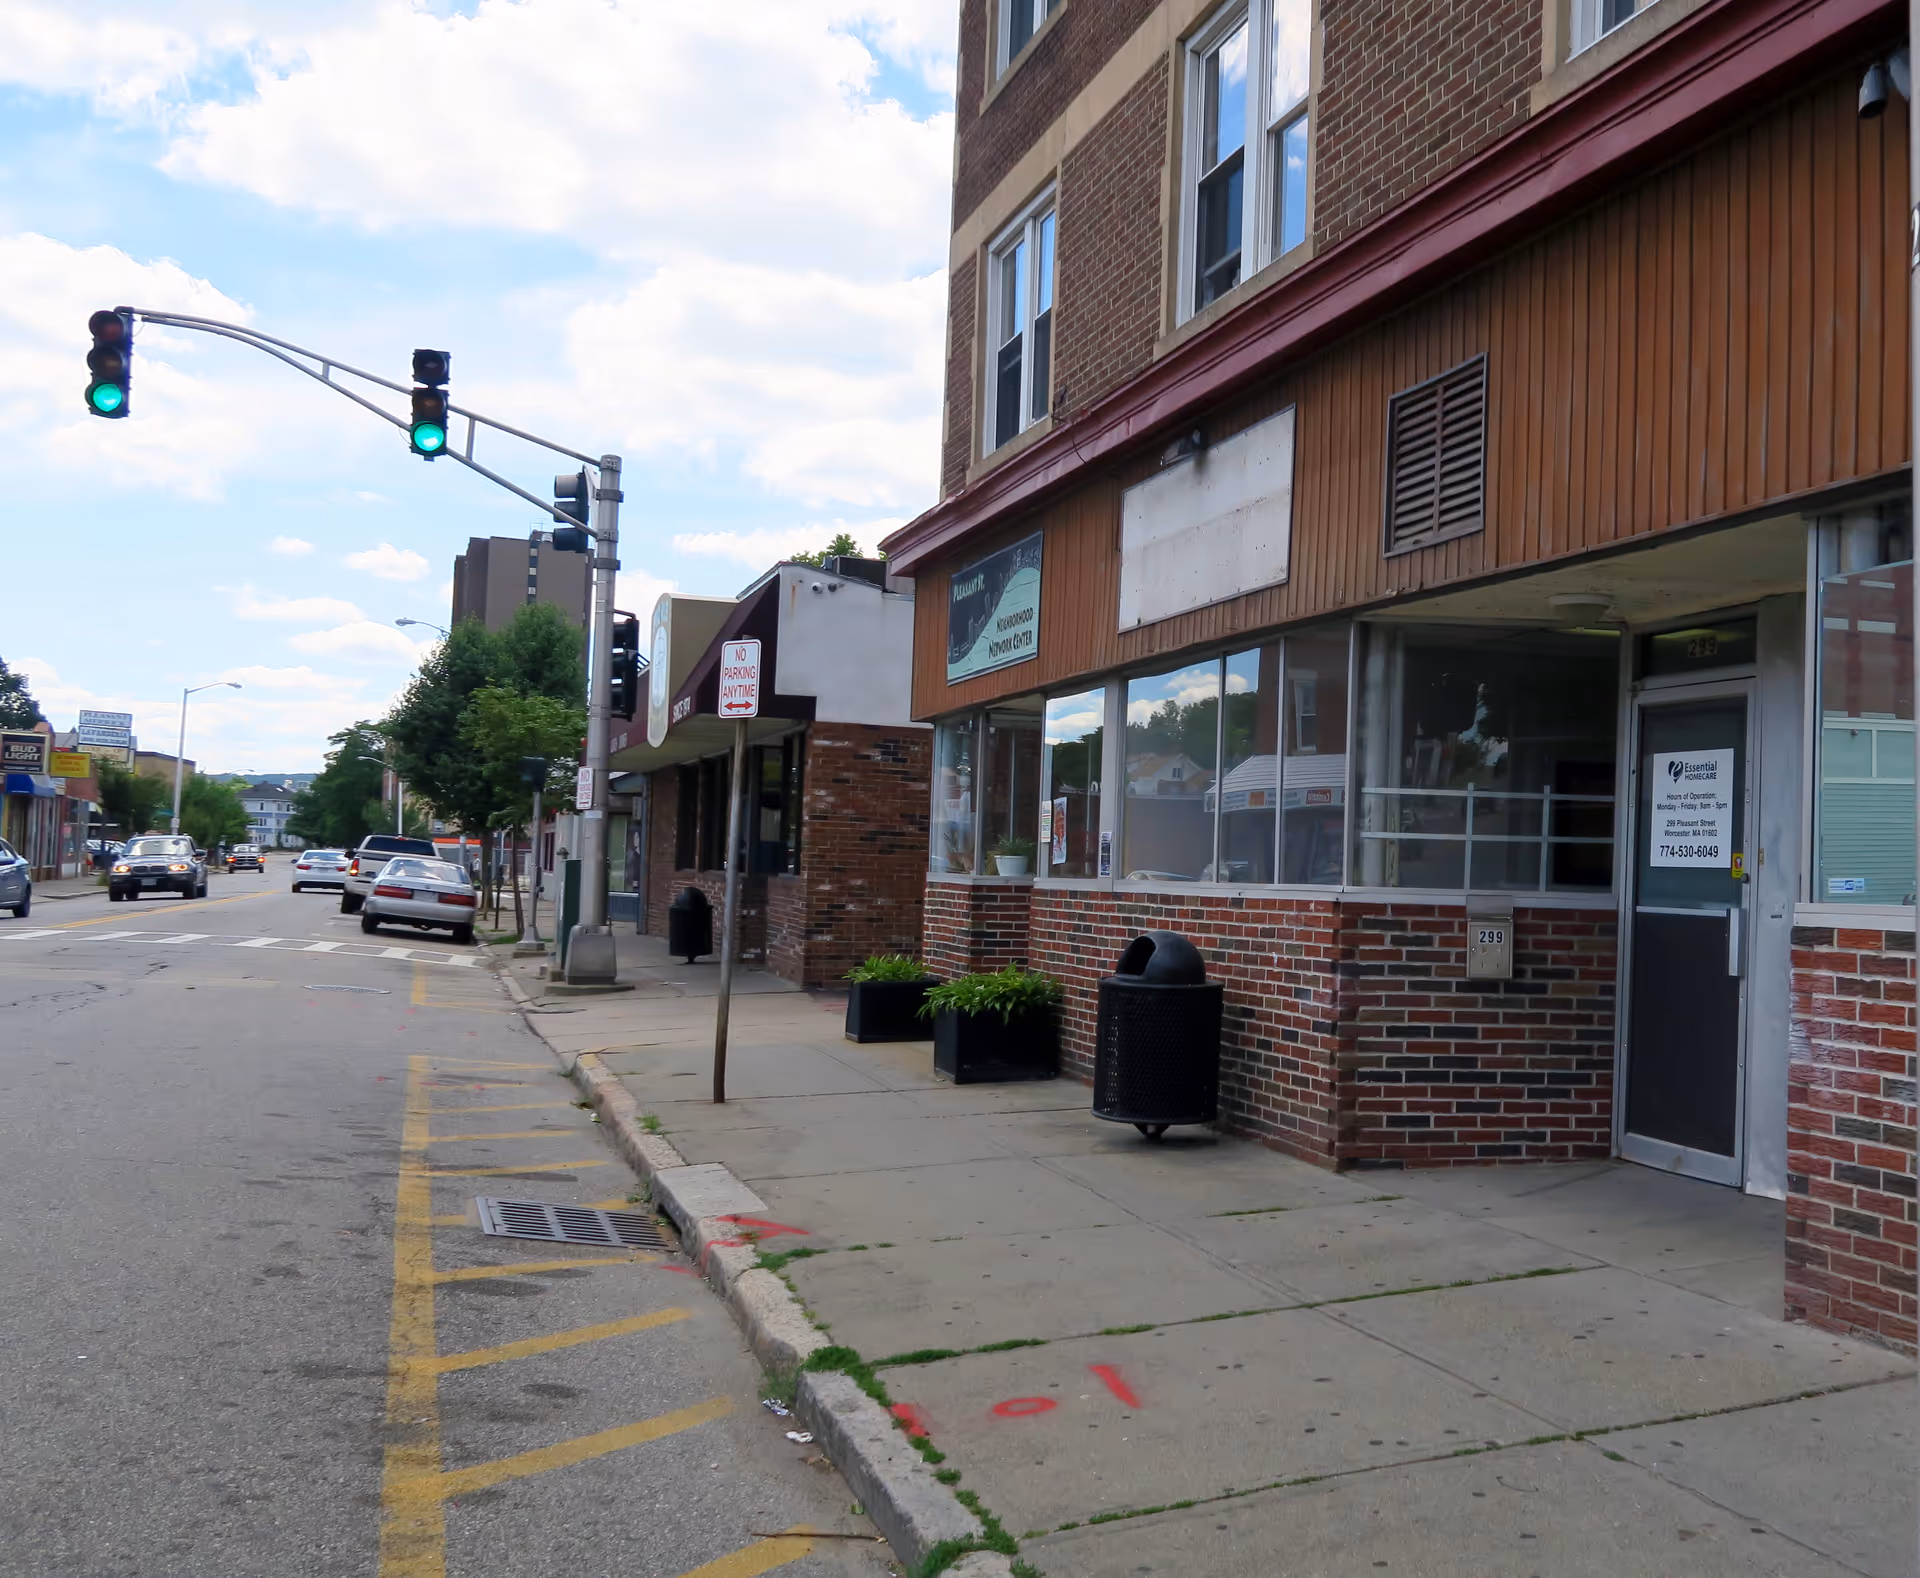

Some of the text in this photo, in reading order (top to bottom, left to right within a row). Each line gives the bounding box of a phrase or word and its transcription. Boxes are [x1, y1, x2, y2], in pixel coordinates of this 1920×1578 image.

[953, 576, 978, 604] PLEASANT
[996, 606, 1034, 633] NEIGHBORHOOD
[988, 629, 1033, 659] NETWORK CENTER
[735, 647, 747, 661] NO
[724, 665, 756, 680] PARKING
[722, 684, 756, 698] ANYTIME
[10, 745, 37, 753] BUD
[4, 752, 41, 760] LIGHT
[1684, 760, 1718, 773] Essential
[1684, 772, 1717, 780] HOMECARE
[1666, 791, 1718, 801] Hours of Operation:
[1656, 803, 1677, 812] Monday
[1699, 802, 1711, 810] 9am
[1715, 801, 1728, 811] 5pm
[1676, 819, 1699, 827] Pleasant
[1699, 819, 1716, 827] Street
[1692, 829, 1702, 837] MA
[1702, 829, 1718, 837] 01602
[1659, 845, 1719, 858] 774-530-6049
[1479, 930, 1503, 944] 299
